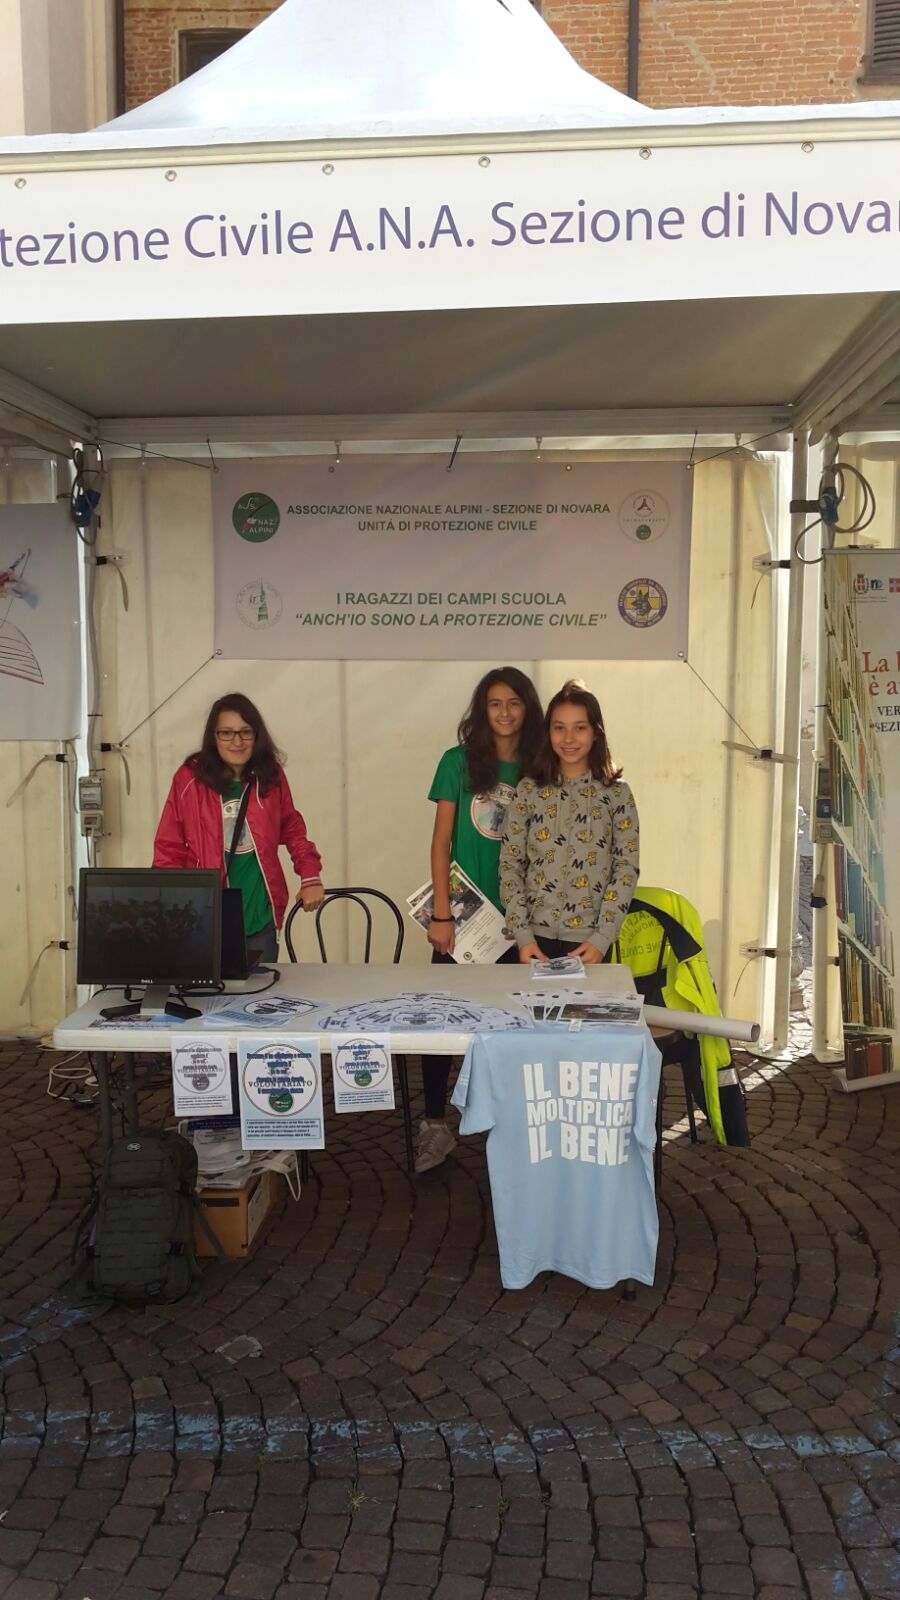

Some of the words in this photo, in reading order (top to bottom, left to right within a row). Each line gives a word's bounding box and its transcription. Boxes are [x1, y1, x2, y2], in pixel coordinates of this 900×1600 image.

[184, 209, 314, 258] Civile
[329, 203, 475, 253] A.N.A.
[490, 198, 685, 247] Sezione
[701, 191, 746, 239] di
[764, 190, 900, 237] Nova
[287, 504, 373, 515] ASSOCIAZIONE
[375, 504, 442, 515] NAZIONALE
[444, 504, 483, 515] ALPINI
[492, 504, 543, 514] SEZIONE
[546, 504, 558, 514] DI
[561, 503, 611, 514] NOVARA
[399, 520, 411, 531] DI
[414, 520, 494, 531] PROTEZIONE
[497, 520, 538, 531] CIVILE
[336, 592, 341, 605] I
[345, 592, 413, 605] RAGAZZI
[417, 592, 443, 605] DEI
[447, 592, 496, 605] CAMPI
[501, 592, 567, 605] SCUOLA
[370, 613, 416, 626] SONO
[419, 613, 440, 626] LA
[443, 613, 544, 626] PROTEZIONE
[861, 651, 890, 673] La
[869, 674, 880, 696] è
[248, 1079, 313, 1088] VOLONTARIATO
[523, 1063, 552, 1101] IL
[558, 1061, 639, 1101] BENE
[526, 1098, 633, 1127] MOLTIPLICA
[528, 1125, 553, 1164] IL
[560, 1122, 632, 1167] BENE
